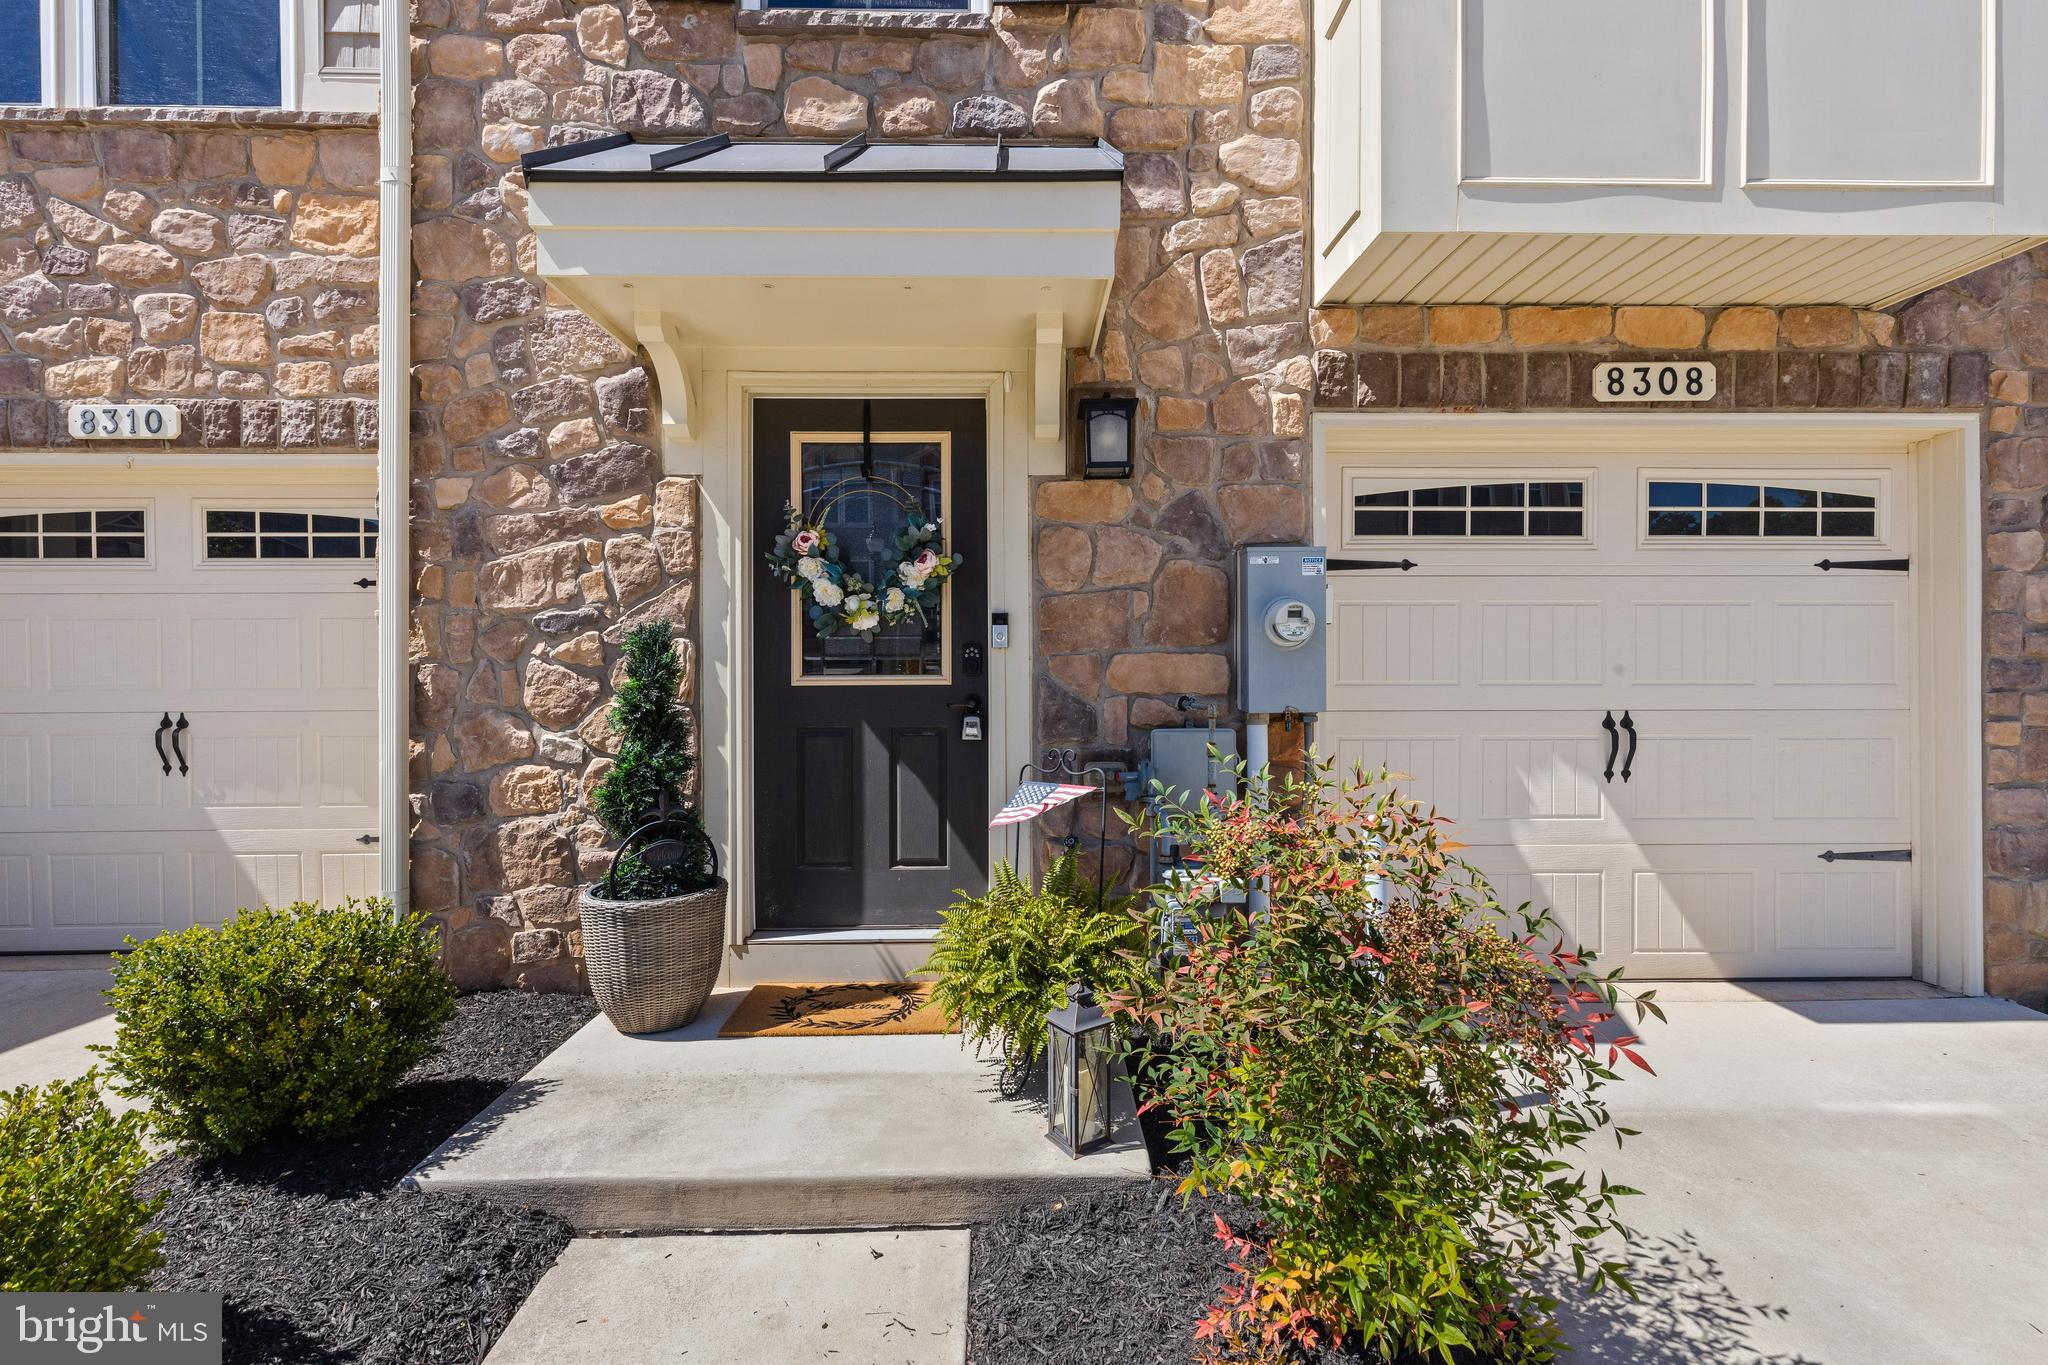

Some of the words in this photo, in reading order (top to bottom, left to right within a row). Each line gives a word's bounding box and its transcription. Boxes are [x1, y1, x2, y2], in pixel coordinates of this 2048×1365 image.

[1607, 367, 1703, 396] 8308
[80, 408, 163, 434] 8310
[645, 846, 684, 862] Welcom
